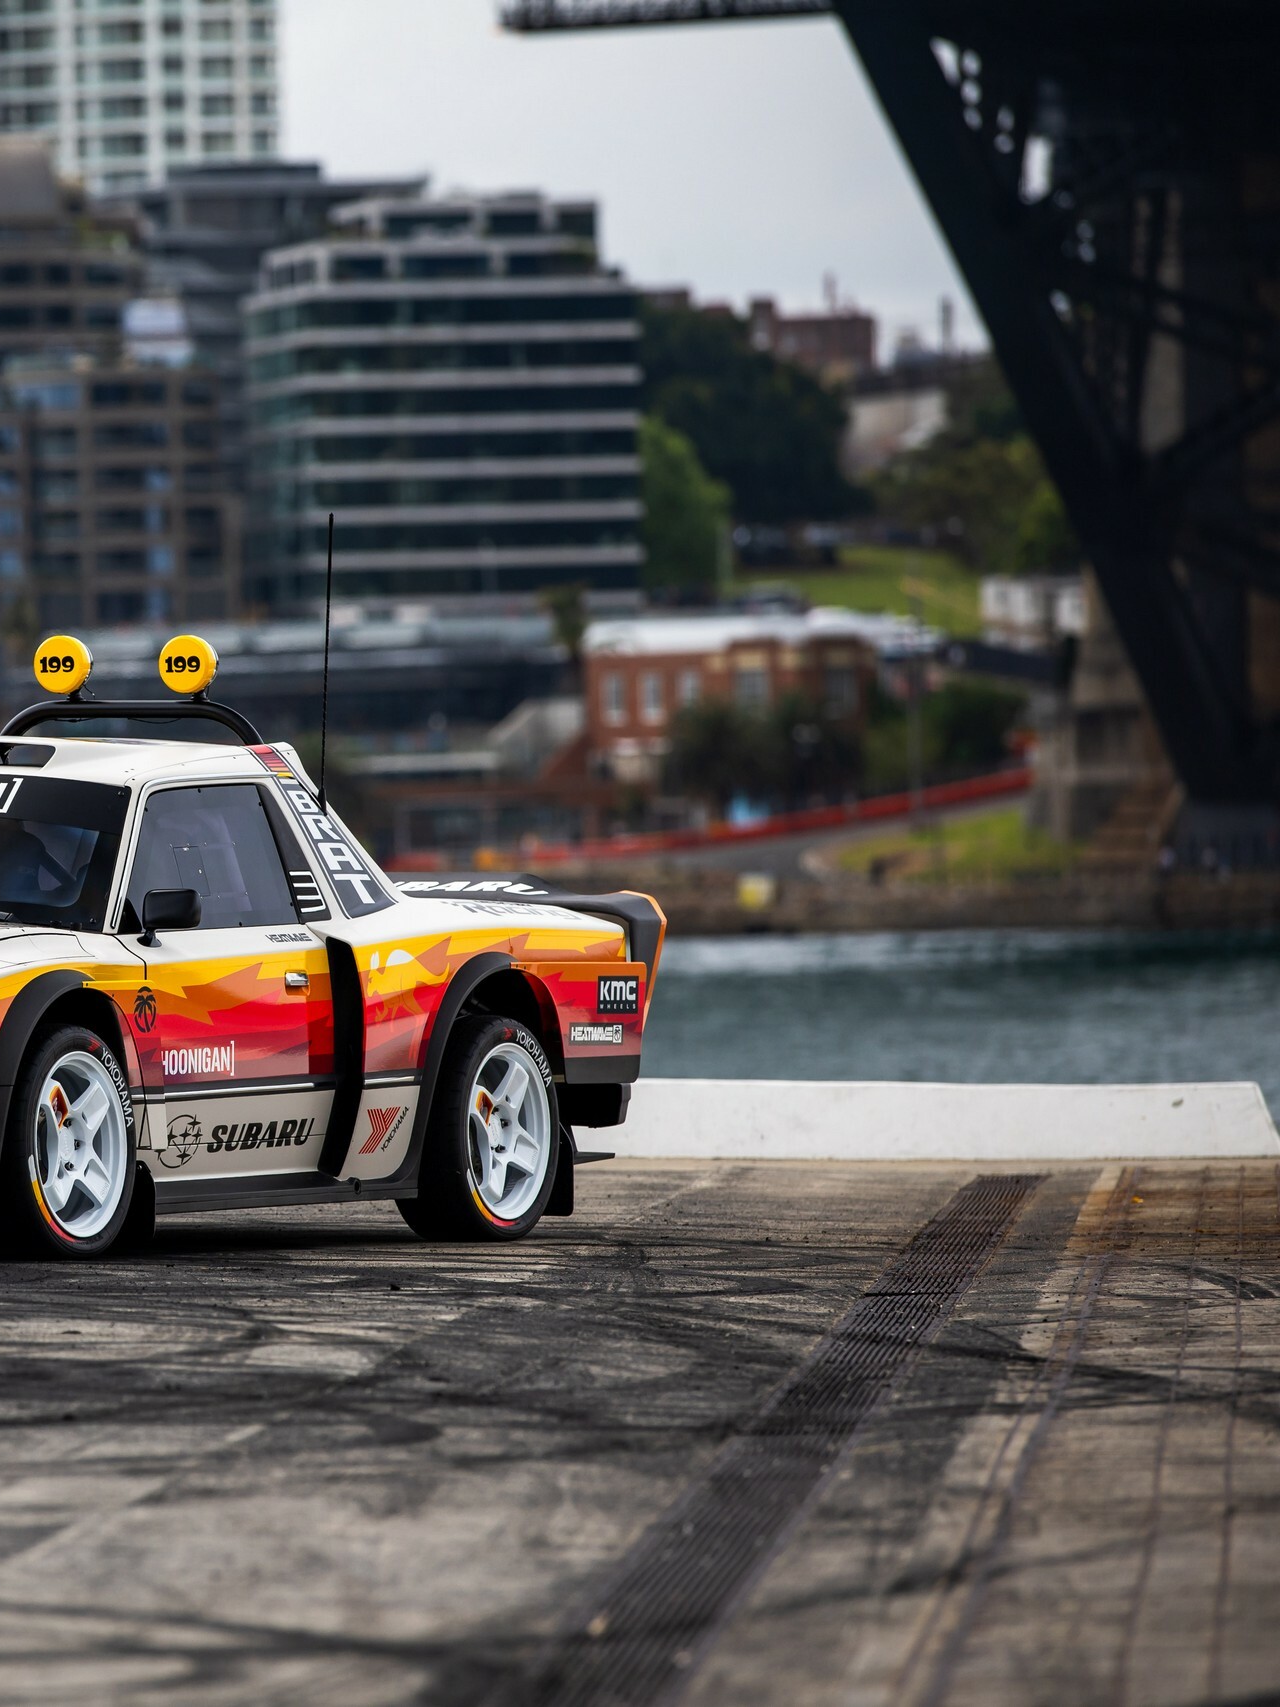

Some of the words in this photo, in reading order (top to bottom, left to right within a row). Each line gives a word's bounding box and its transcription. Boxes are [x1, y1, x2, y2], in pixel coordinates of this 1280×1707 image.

[39, 656, 75, 673] 199
[165, 655, 201, 673] 199
[287, 790, 376, 904] BRAT
[393, 881, 549, 895] BARU
[600, 980, 637, 1001] KMC
[571, 1026, 613, 1041] HEATWAVE
[516, 1029, 552, 1088] YOKOHAMA
[101, 1047, 134, 1127] YOKOHAMA
[207, 1118, 315, 1153] SUBARU
